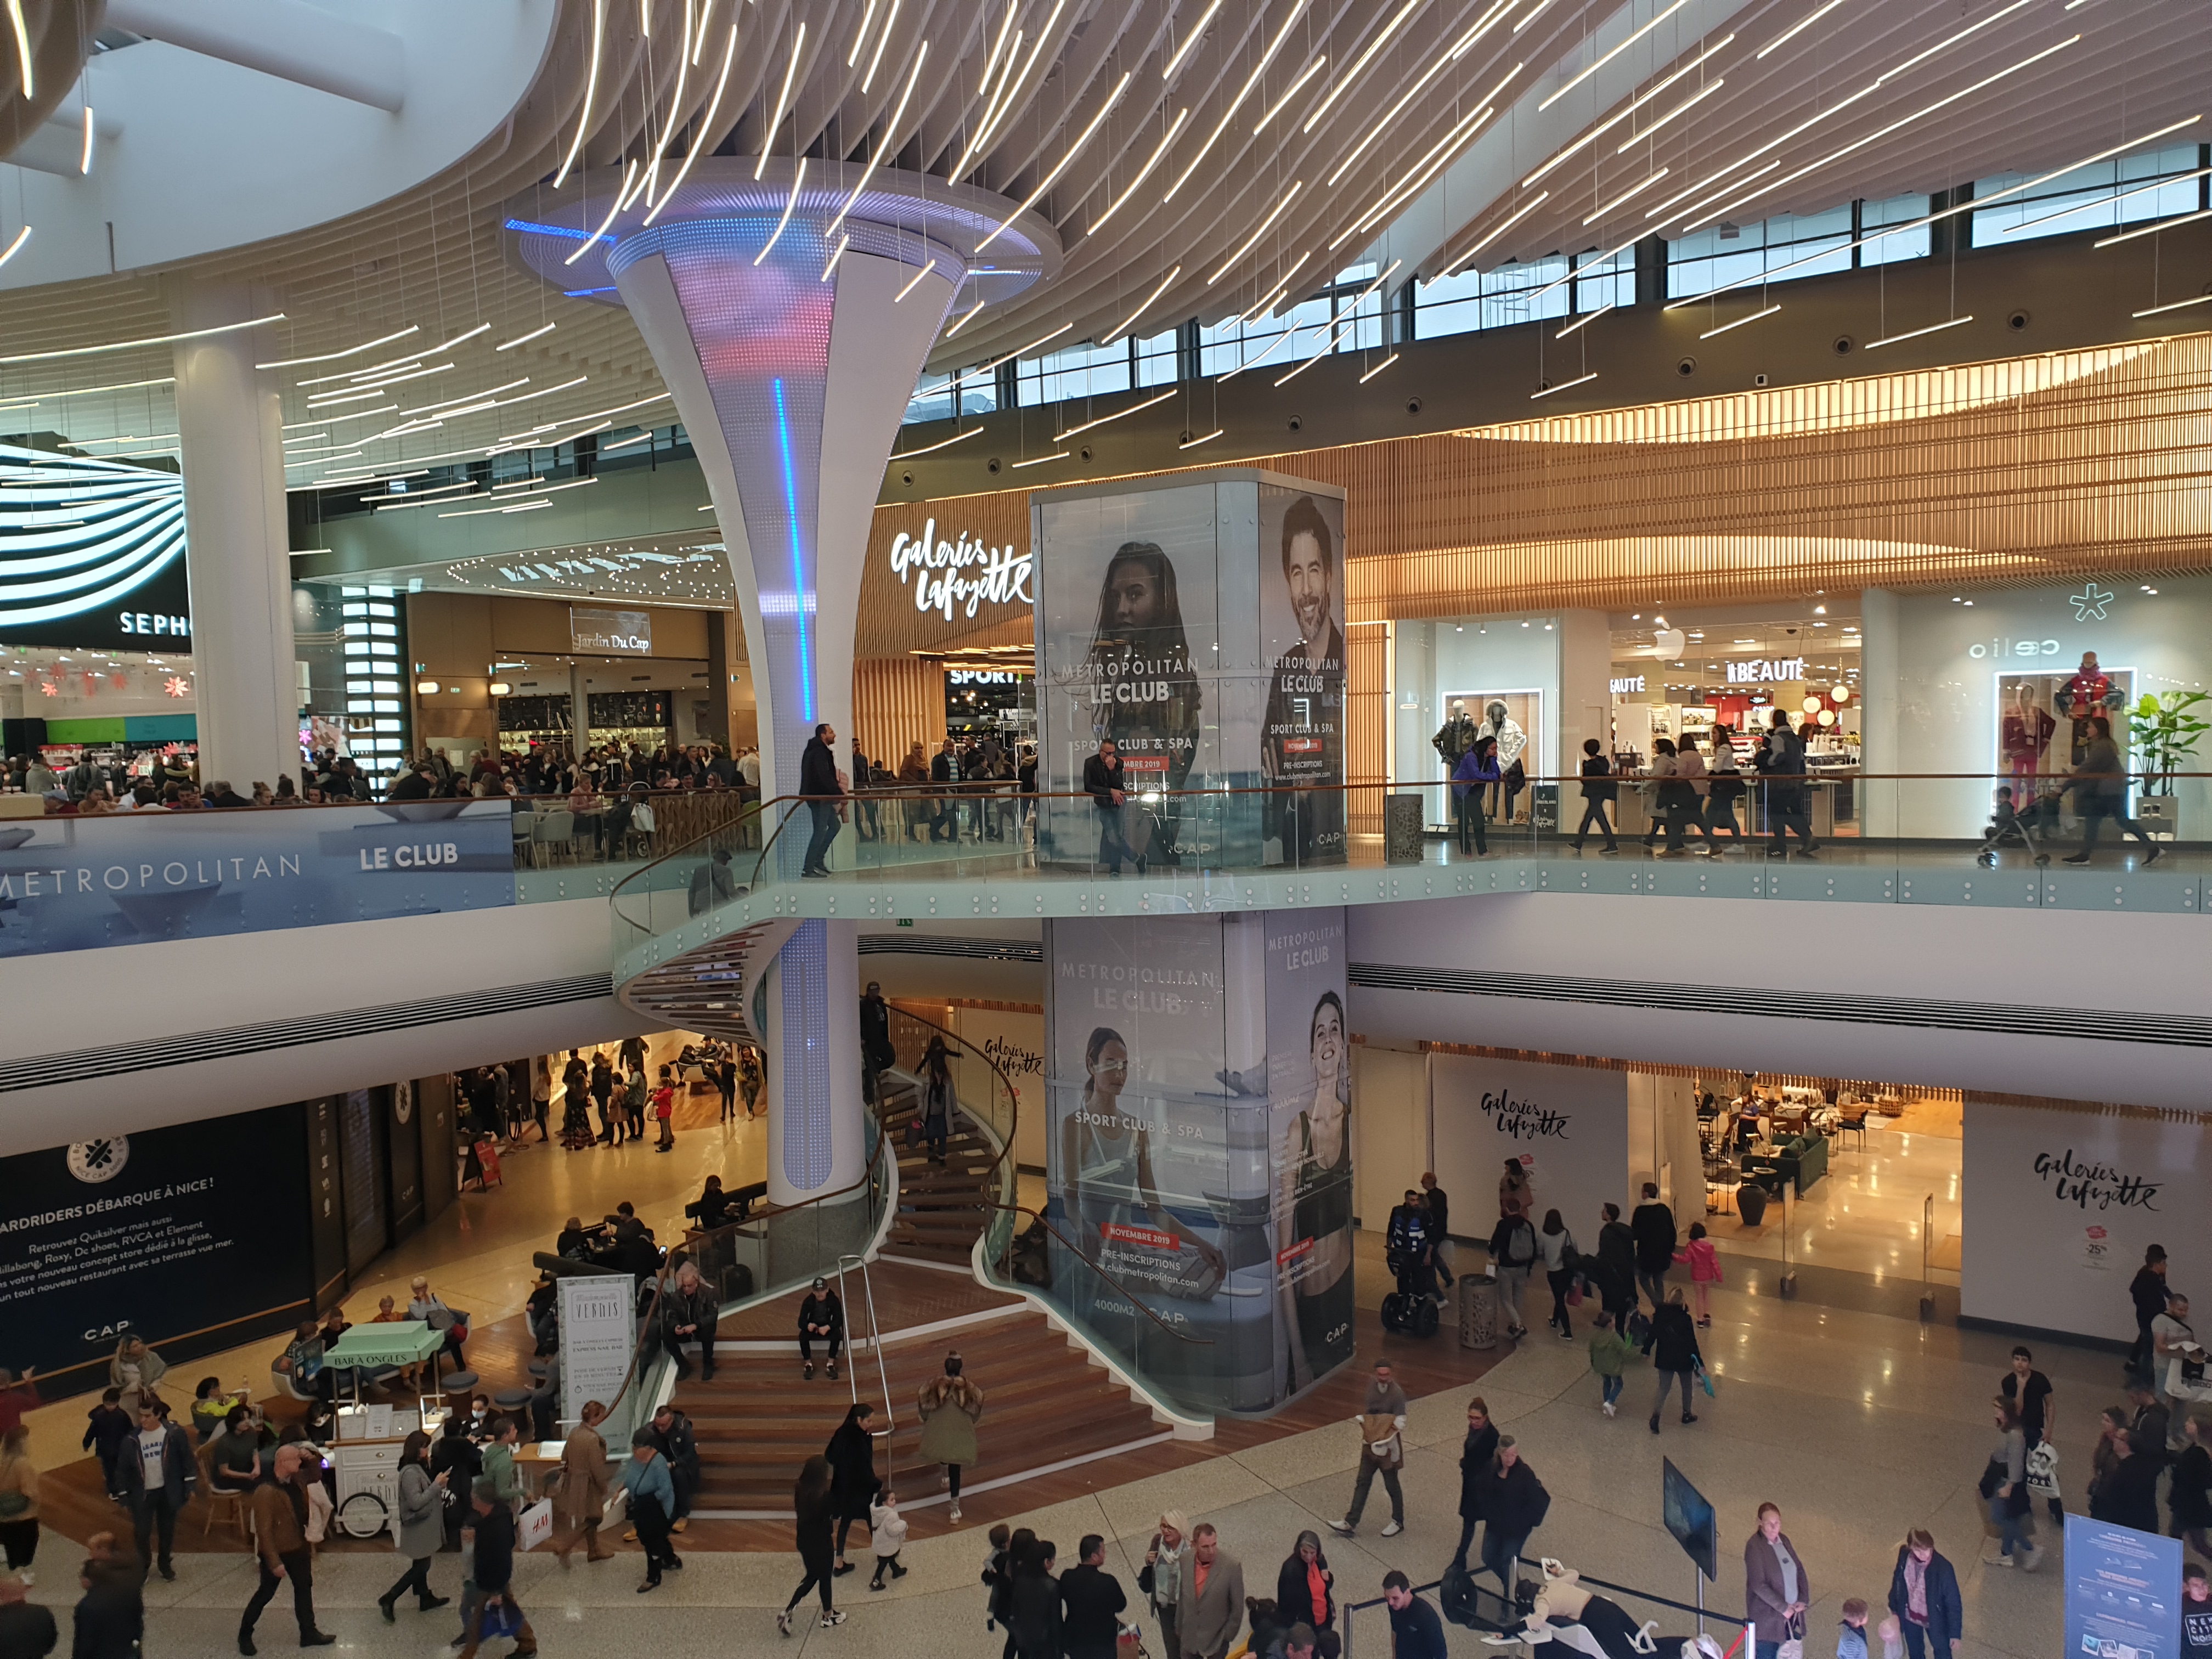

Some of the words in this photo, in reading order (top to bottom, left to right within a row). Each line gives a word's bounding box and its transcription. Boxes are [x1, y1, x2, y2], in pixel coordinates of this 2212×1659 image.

[891, 518, 988, 584] Galeries
[916, 545, 1034, 622] Lafayette
[120, 612, 191, 636] SEPH
[574, 633, 610, 650] Jardin
[611, 635, 628, 648] Du
[629, 635, 649, 653] Cap
[1062, 658, 1198, 679] METROPOLITAN
[1266, 655, 1339, 671] METROPOLITAN
[1091, 684, 1113, 704] LE
[1116, 681, 1170, 703] CLUB
[1281, 675, 1295, 693] LE
[1295, 675, 1324, 693] CLUB
[1271, 724, 1293, 735] SPORT
[1295, 723, 1312, 734] CLUB
[1314, 723, 1319, 733] &
[1322, 723, 1334, 733] SPA
[1074, 740, 1102, 751] SPO
[1118, 739, 1148, 751] CLUB
[1154, 738, 1163, 750] &
[1169, 737, 1193, 750] SPA
[1144, 760, 1160, 768] 2019
[1284, 760, 1323, 769] PRE-INSCRIPTIONS
[360, 847, 388, 870] LE
[394, 843, 458, 867] CLUB
[1268, 925, 1342, 951] METROPOLITAN
[1286, 951, 1300, 971] LE
[1301, 945, 1329, 967] CLUB
[1062, 962, 1214, 988] METROPOLITAN
[1093, 988, 1118, 1010] LE
[1122, 989, 1181, 1015] CLUB
[985, 1035, 1024, 1058] Galeries
[1481, 1089, 1541, 1116] Galeries
[1075, 1111, 1117, 1128] SPORT
[1122, 1117, 1155, 1132] CLUB
[1161, 1122, 1171, 1135] &
[1178, 1125, 1204, 1139] SPA
[1497, 1110, 1572, 1140] Lafayette
[2034, 1149, 2119, 1181] Galeries
[86, 1188, 161, 1215] DÉBARQUE
[163, 1184, 174, 1198] À
[2056, 1175, 2165, 1211] Lafayette
[29, 1238, 77, 1254] Retrouvez
[80, 1227, 127, 1244] Quiksilver
[128, 1220, 149, 1232] mais
[151, 1214, 173, 1227] aussi
[45, 1254, 72, 1264] Roxy,
[122, 1231, 153, 1246] RVCA
[155, 1229, 165, 1238] et
[167, 1221, 203, 1235] Element
[1110, 1227, 1152, 1242] NOVEMBRE
[1153, 1235, 1170, 1245] 2019
[9, 1274, 35, 1286] votre
[38, 1264, 78, 1279] nouveau
[80, 1254, 117, 1269] concept
[120, 1249, 143, 1260] store
[14, 1287, 35, 1299] tout
[37, 1277, 77, 1293] nouveau
[80, 1264, 126, 1283] restaurant
[129, 1260, 149, 1269] avec
[198, 1244, 213, 1253] vue
[1101, 1248, 1181, 1271] PRE-INSCRIPTIONS
[577, 1302, 618, 1318] VERNIS
[1094, 1299, 1135, 1317] 4000M2
[335, 1357, 354, 1365] BAR
[357, 1355, 364, 1364] À
[366, 1354, 407, 1364] ONGLES
